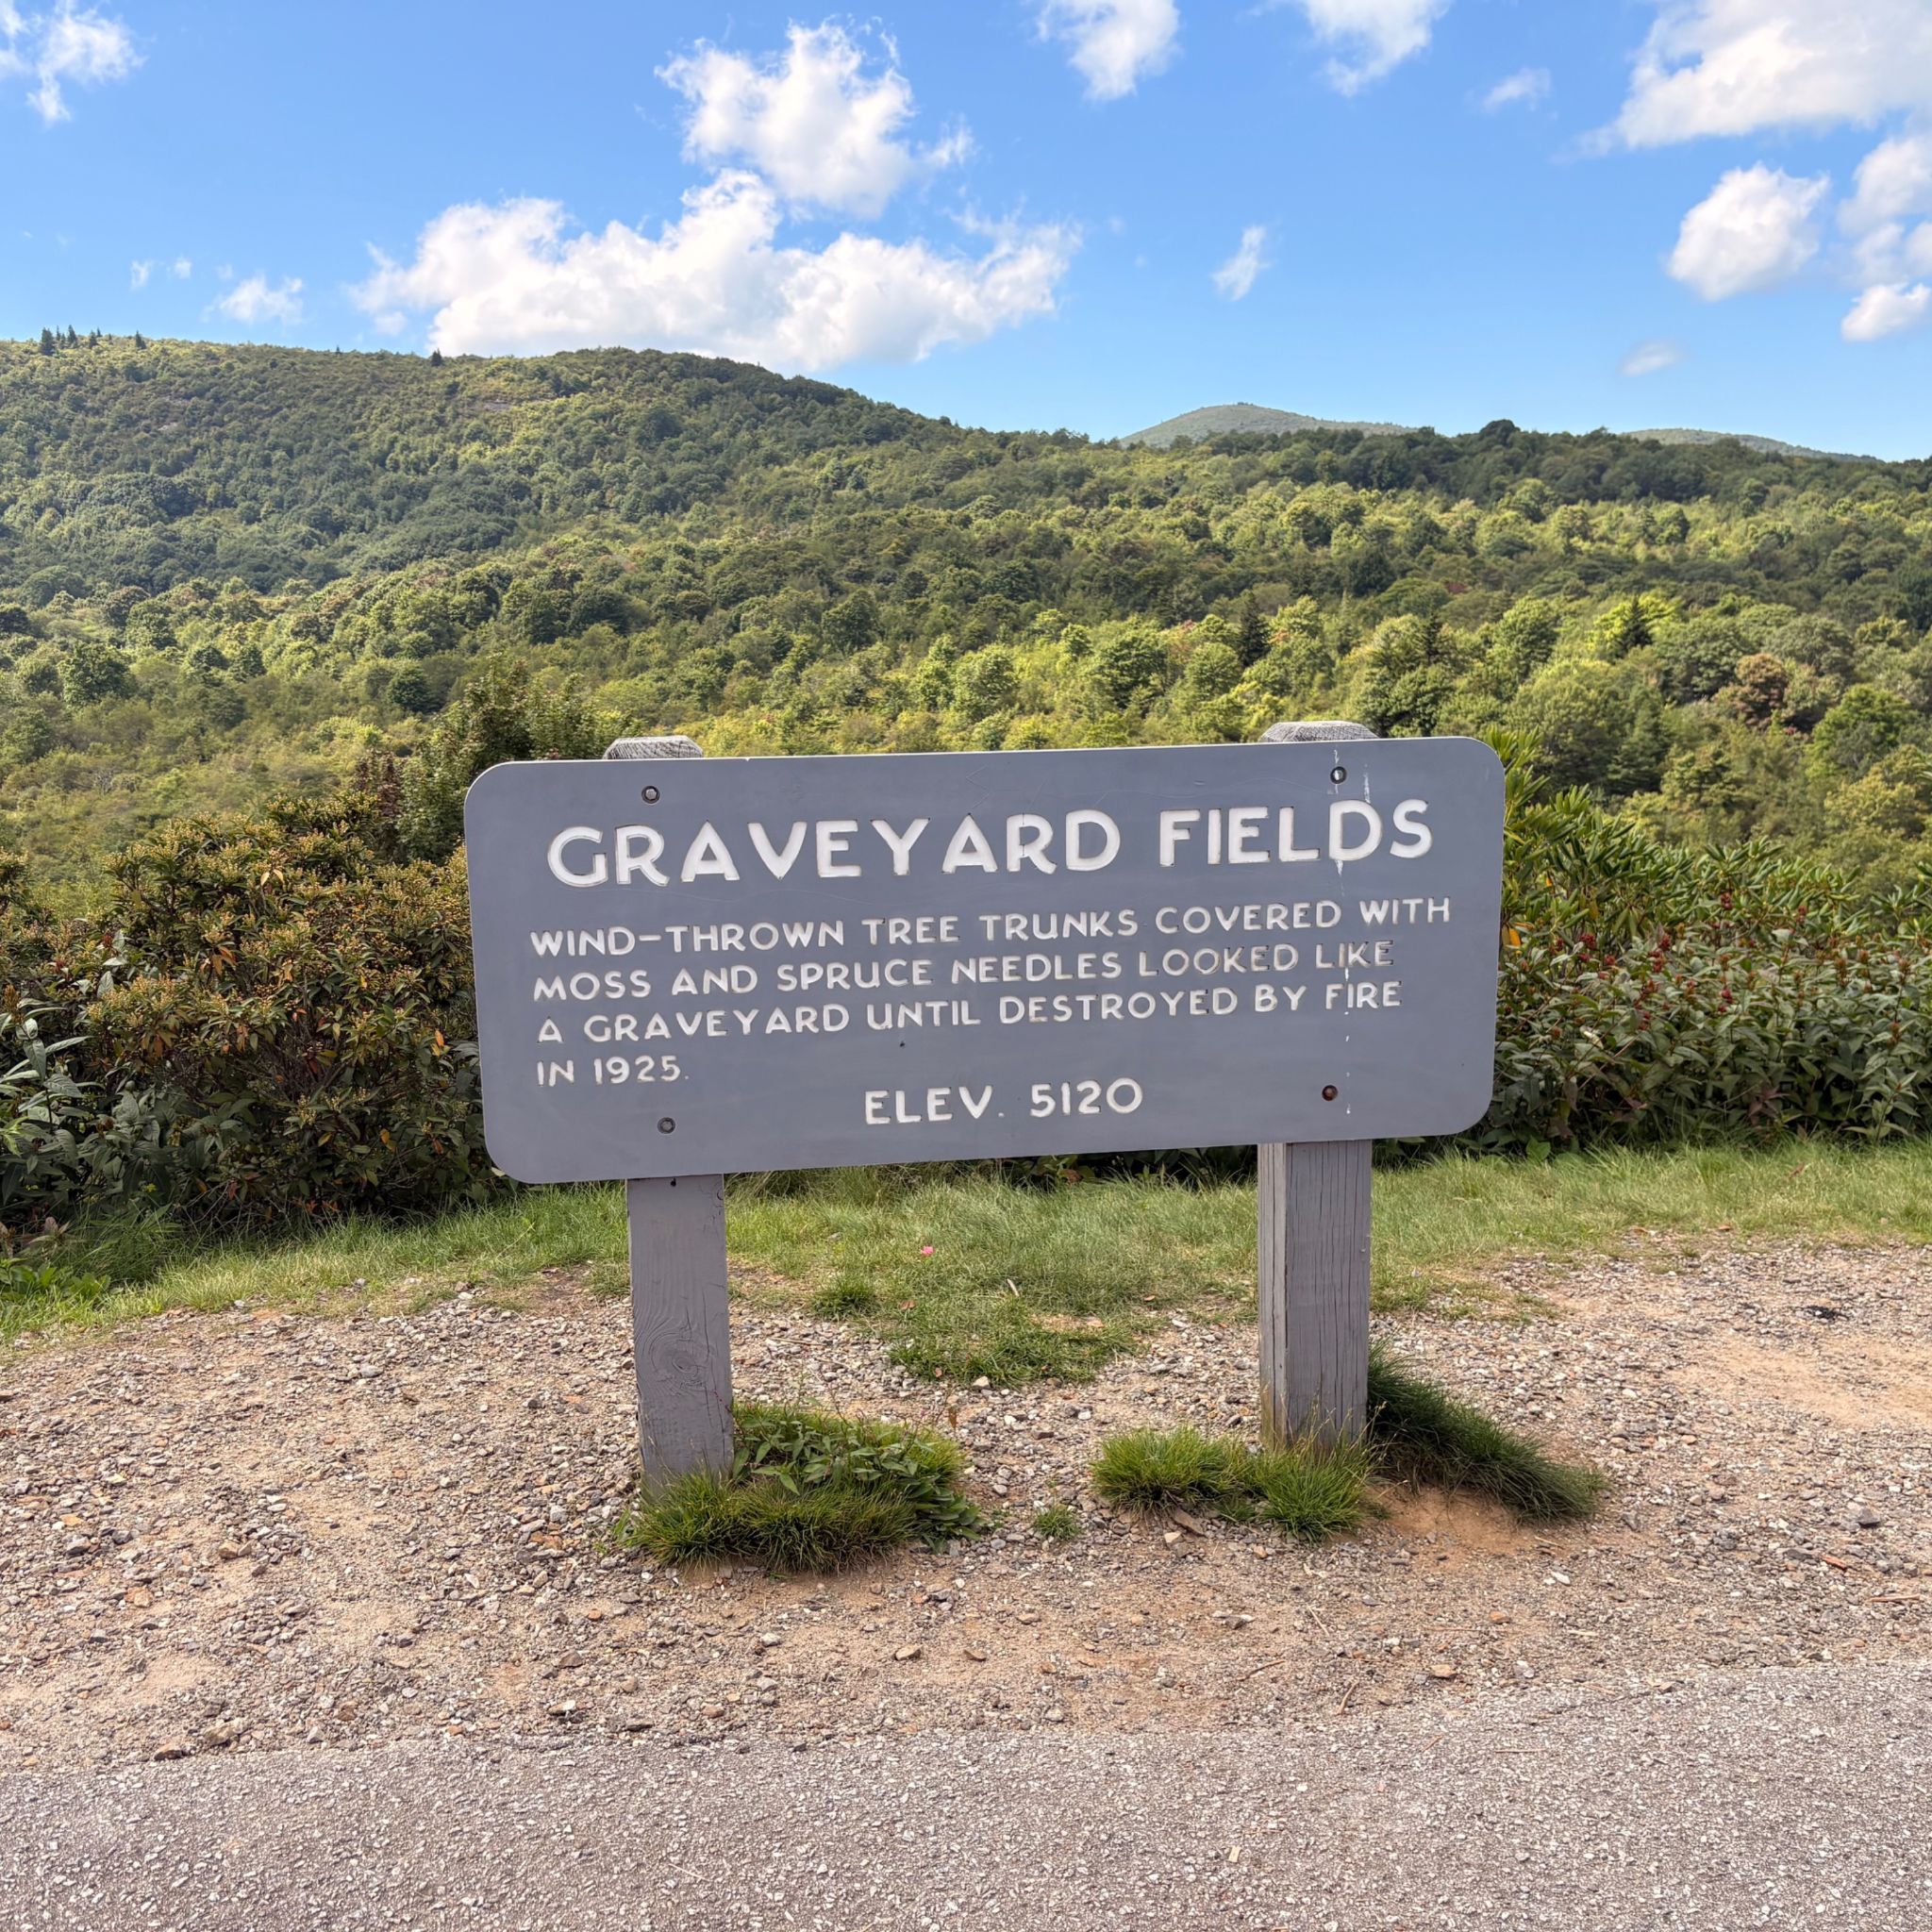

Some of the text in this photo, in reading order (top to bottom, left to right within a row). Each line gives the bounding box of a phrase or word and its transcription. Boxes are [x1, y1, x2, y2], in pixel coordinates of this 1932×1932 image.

[546, 798, 1433, 888] GRAVEYARD FIELDS
[529, 897, 1450, 958] WIND-THROWN TREE TRUNKS COVERED WITH
[533, 940, 1394, 1002] MOSS AND SPRUCE NEEDLES LOOKED LIKE
[537, 981, 1402, 1044] A GRAVEYARD UNTIL DESTROYED BY FIRE
[537, 1059, 575, 1088] IN
[1030, 1077, 1143, 1118] 5120
